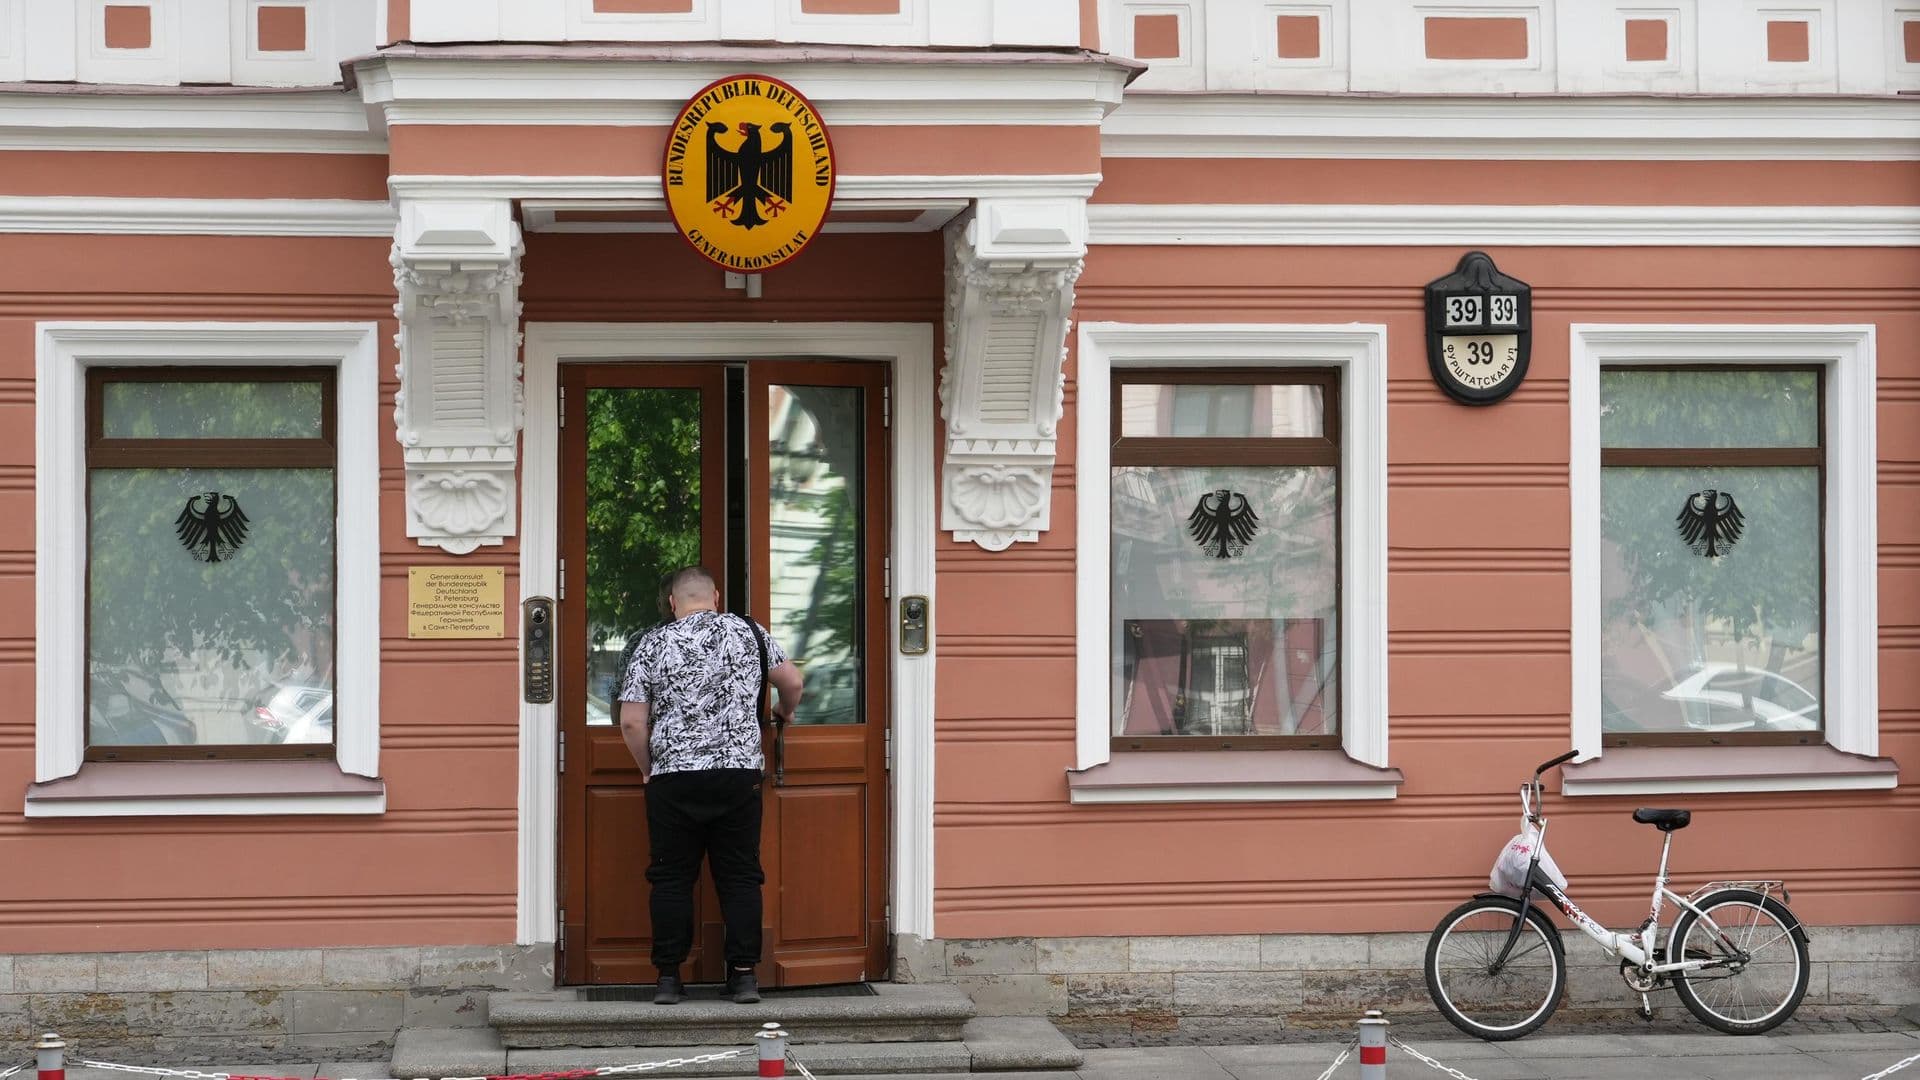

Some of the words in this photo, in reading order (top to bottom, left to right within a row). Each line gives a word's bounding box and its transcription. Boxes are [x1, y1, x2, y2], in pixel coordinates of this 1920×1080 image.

[669, 80, 762, 186] BUNDESREPUBLIK
[766, 84, 830, 187] DEUTSCHLAND
[688, 229, 808, 268] GENERALKONSULAT
[1451, 299, 1477, 322] 39
[1494, 298, 1513, 321] 39
[1447, 344, 1510, 386] ФУРШТАТСКАЯ
[1467, 342, 1493, 365] 39
